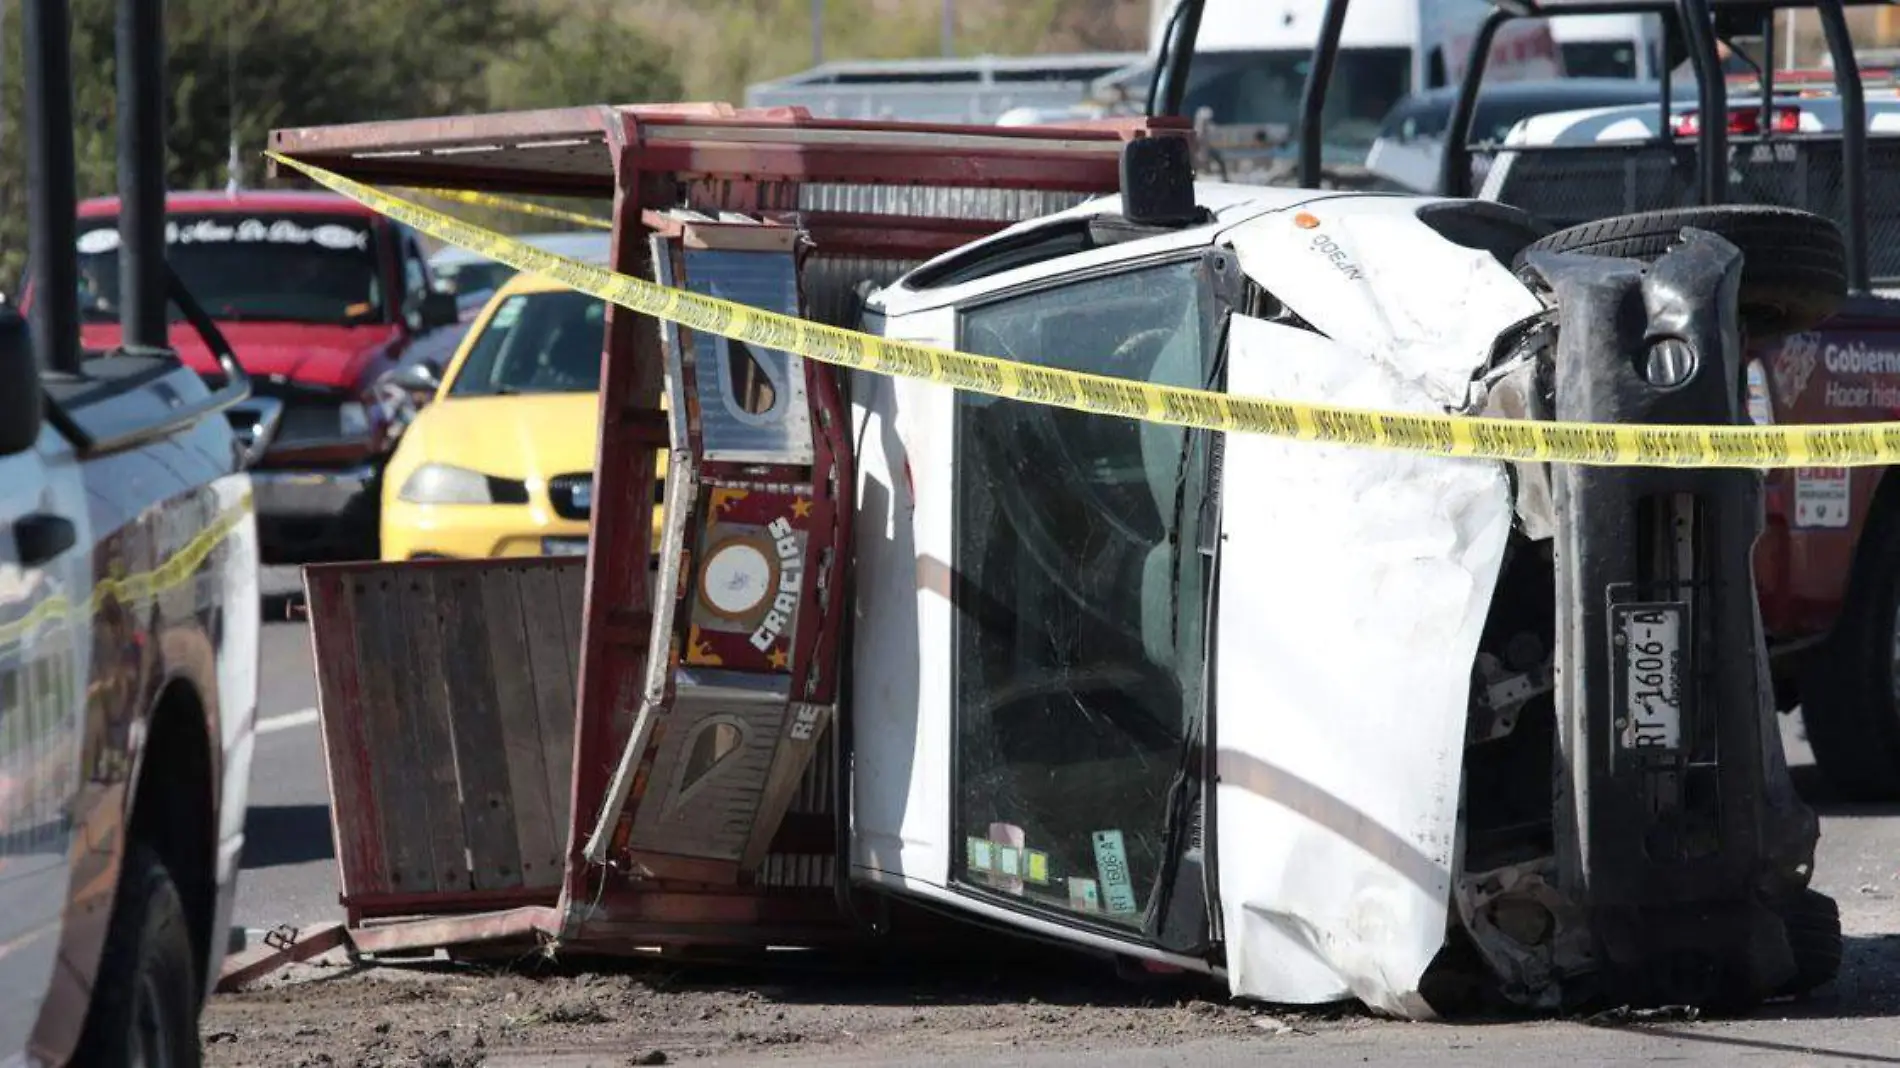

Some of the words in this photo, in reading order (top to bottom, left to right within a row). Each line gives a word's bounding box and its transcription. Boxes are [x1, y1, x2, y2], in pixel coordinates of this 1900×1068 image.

[1312, 233, 1363, 281] NP300
[1825, 382, 1868, 407] Hacer
[749, 516, 801, 652] GRACIAS
